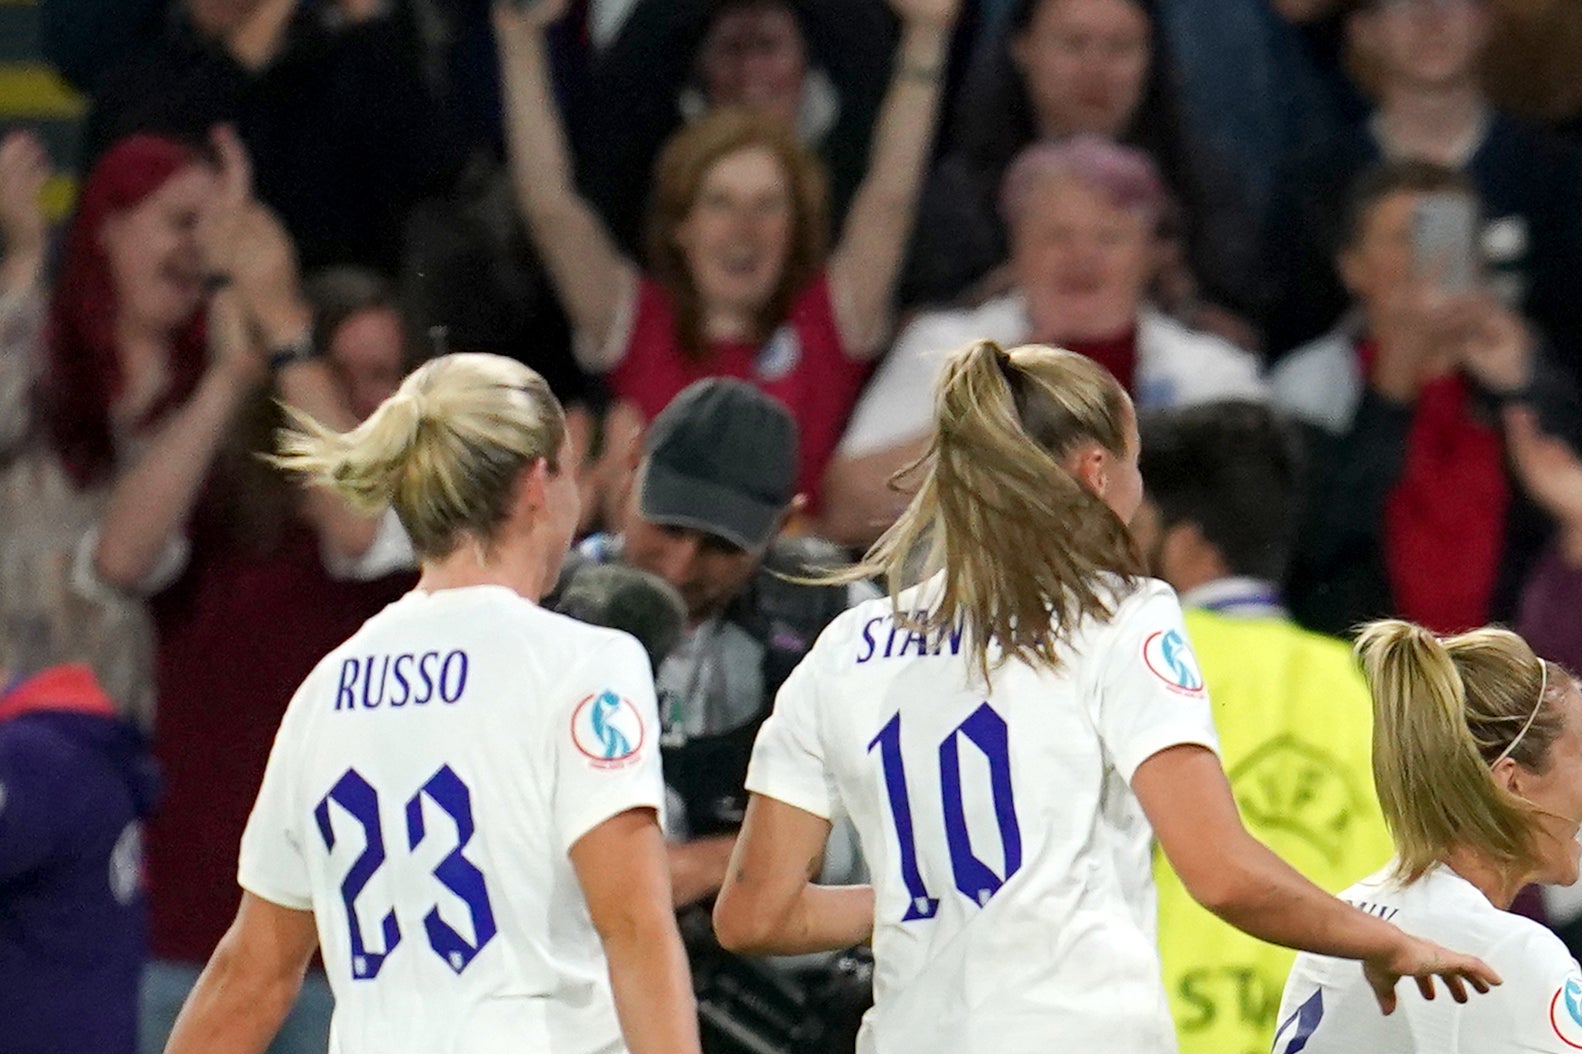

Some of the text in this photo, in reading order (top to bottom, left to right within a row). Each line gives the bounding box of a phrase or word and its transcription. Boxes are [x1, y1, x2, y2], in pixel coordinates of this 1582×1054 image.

[334, 649, 469, 711] RUSSO
[856, 609, 1003, 664] STAN
[314, 762, 497, 980] 23
[868, 701, 1022, 922] 10
